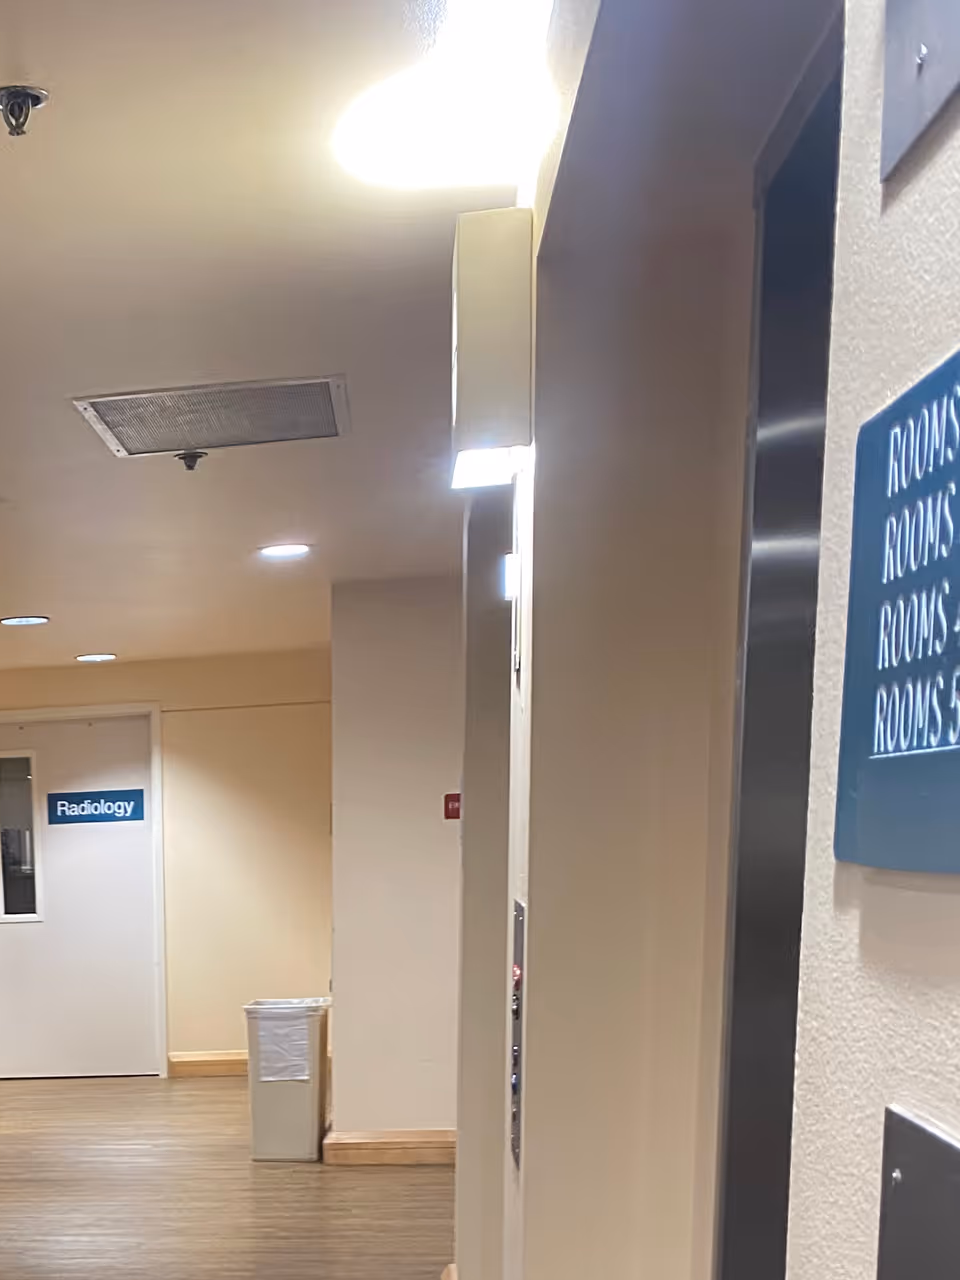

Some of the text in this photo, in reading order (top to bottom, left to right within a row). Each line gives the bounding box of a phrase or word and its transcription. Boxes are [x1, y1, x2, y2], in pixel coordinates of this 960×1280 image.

[886, 384, 960, 497] ROOMS
[882, 480, 956, 584] ROOMS
[878, 577, 949, 670] ROOMS
[874, 671, 944, 753] ROOMS
[56, 799, 135, 817] Radiology
